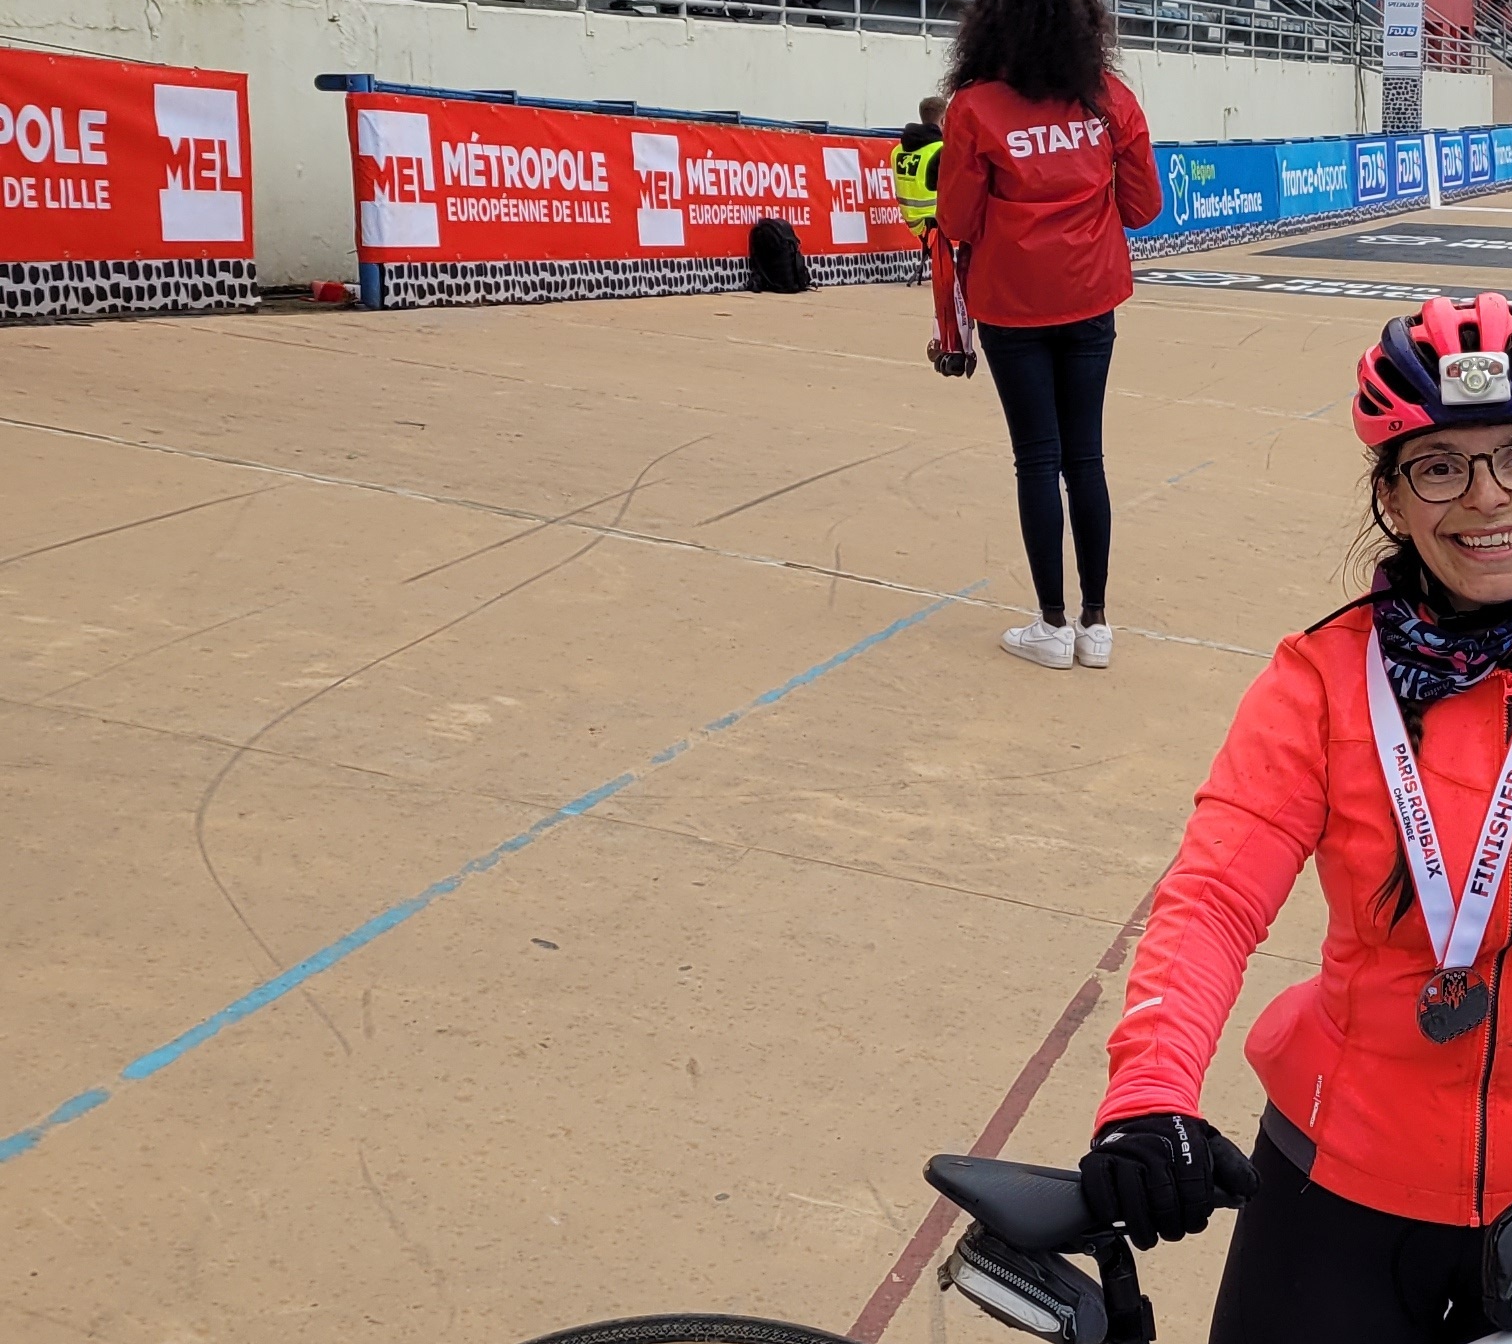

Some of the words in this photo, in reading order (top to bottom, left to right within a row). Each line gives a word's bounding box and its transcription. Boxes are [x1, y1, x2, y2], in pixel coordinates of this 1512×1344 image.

[1006, 117, 1108, 158] STAFF
[442, 131, 608, 193] MÉTROPOLE
[686, 149, 808, 199] MÉTROPOLE
[1190, 159, 1216, 186] Région
[3, 176, 39, 209] DE
[45, 177, 112, 211] LILLE
[446, 195, 549, 224] EUROPÉENNE
[552, 200, 573, 223] DE
[575, 200, 611, 225] LILLE
[1192, 187, 1263, 220] Hauts-de-France
[688, 203, 763, 227] EUROPÉENNE
[1392, 743, 1418, 798] PARIS
[1407, 795, 1443, 881] ROUBAIX
[1393, 787, 1416, 843] CHALLENGE
